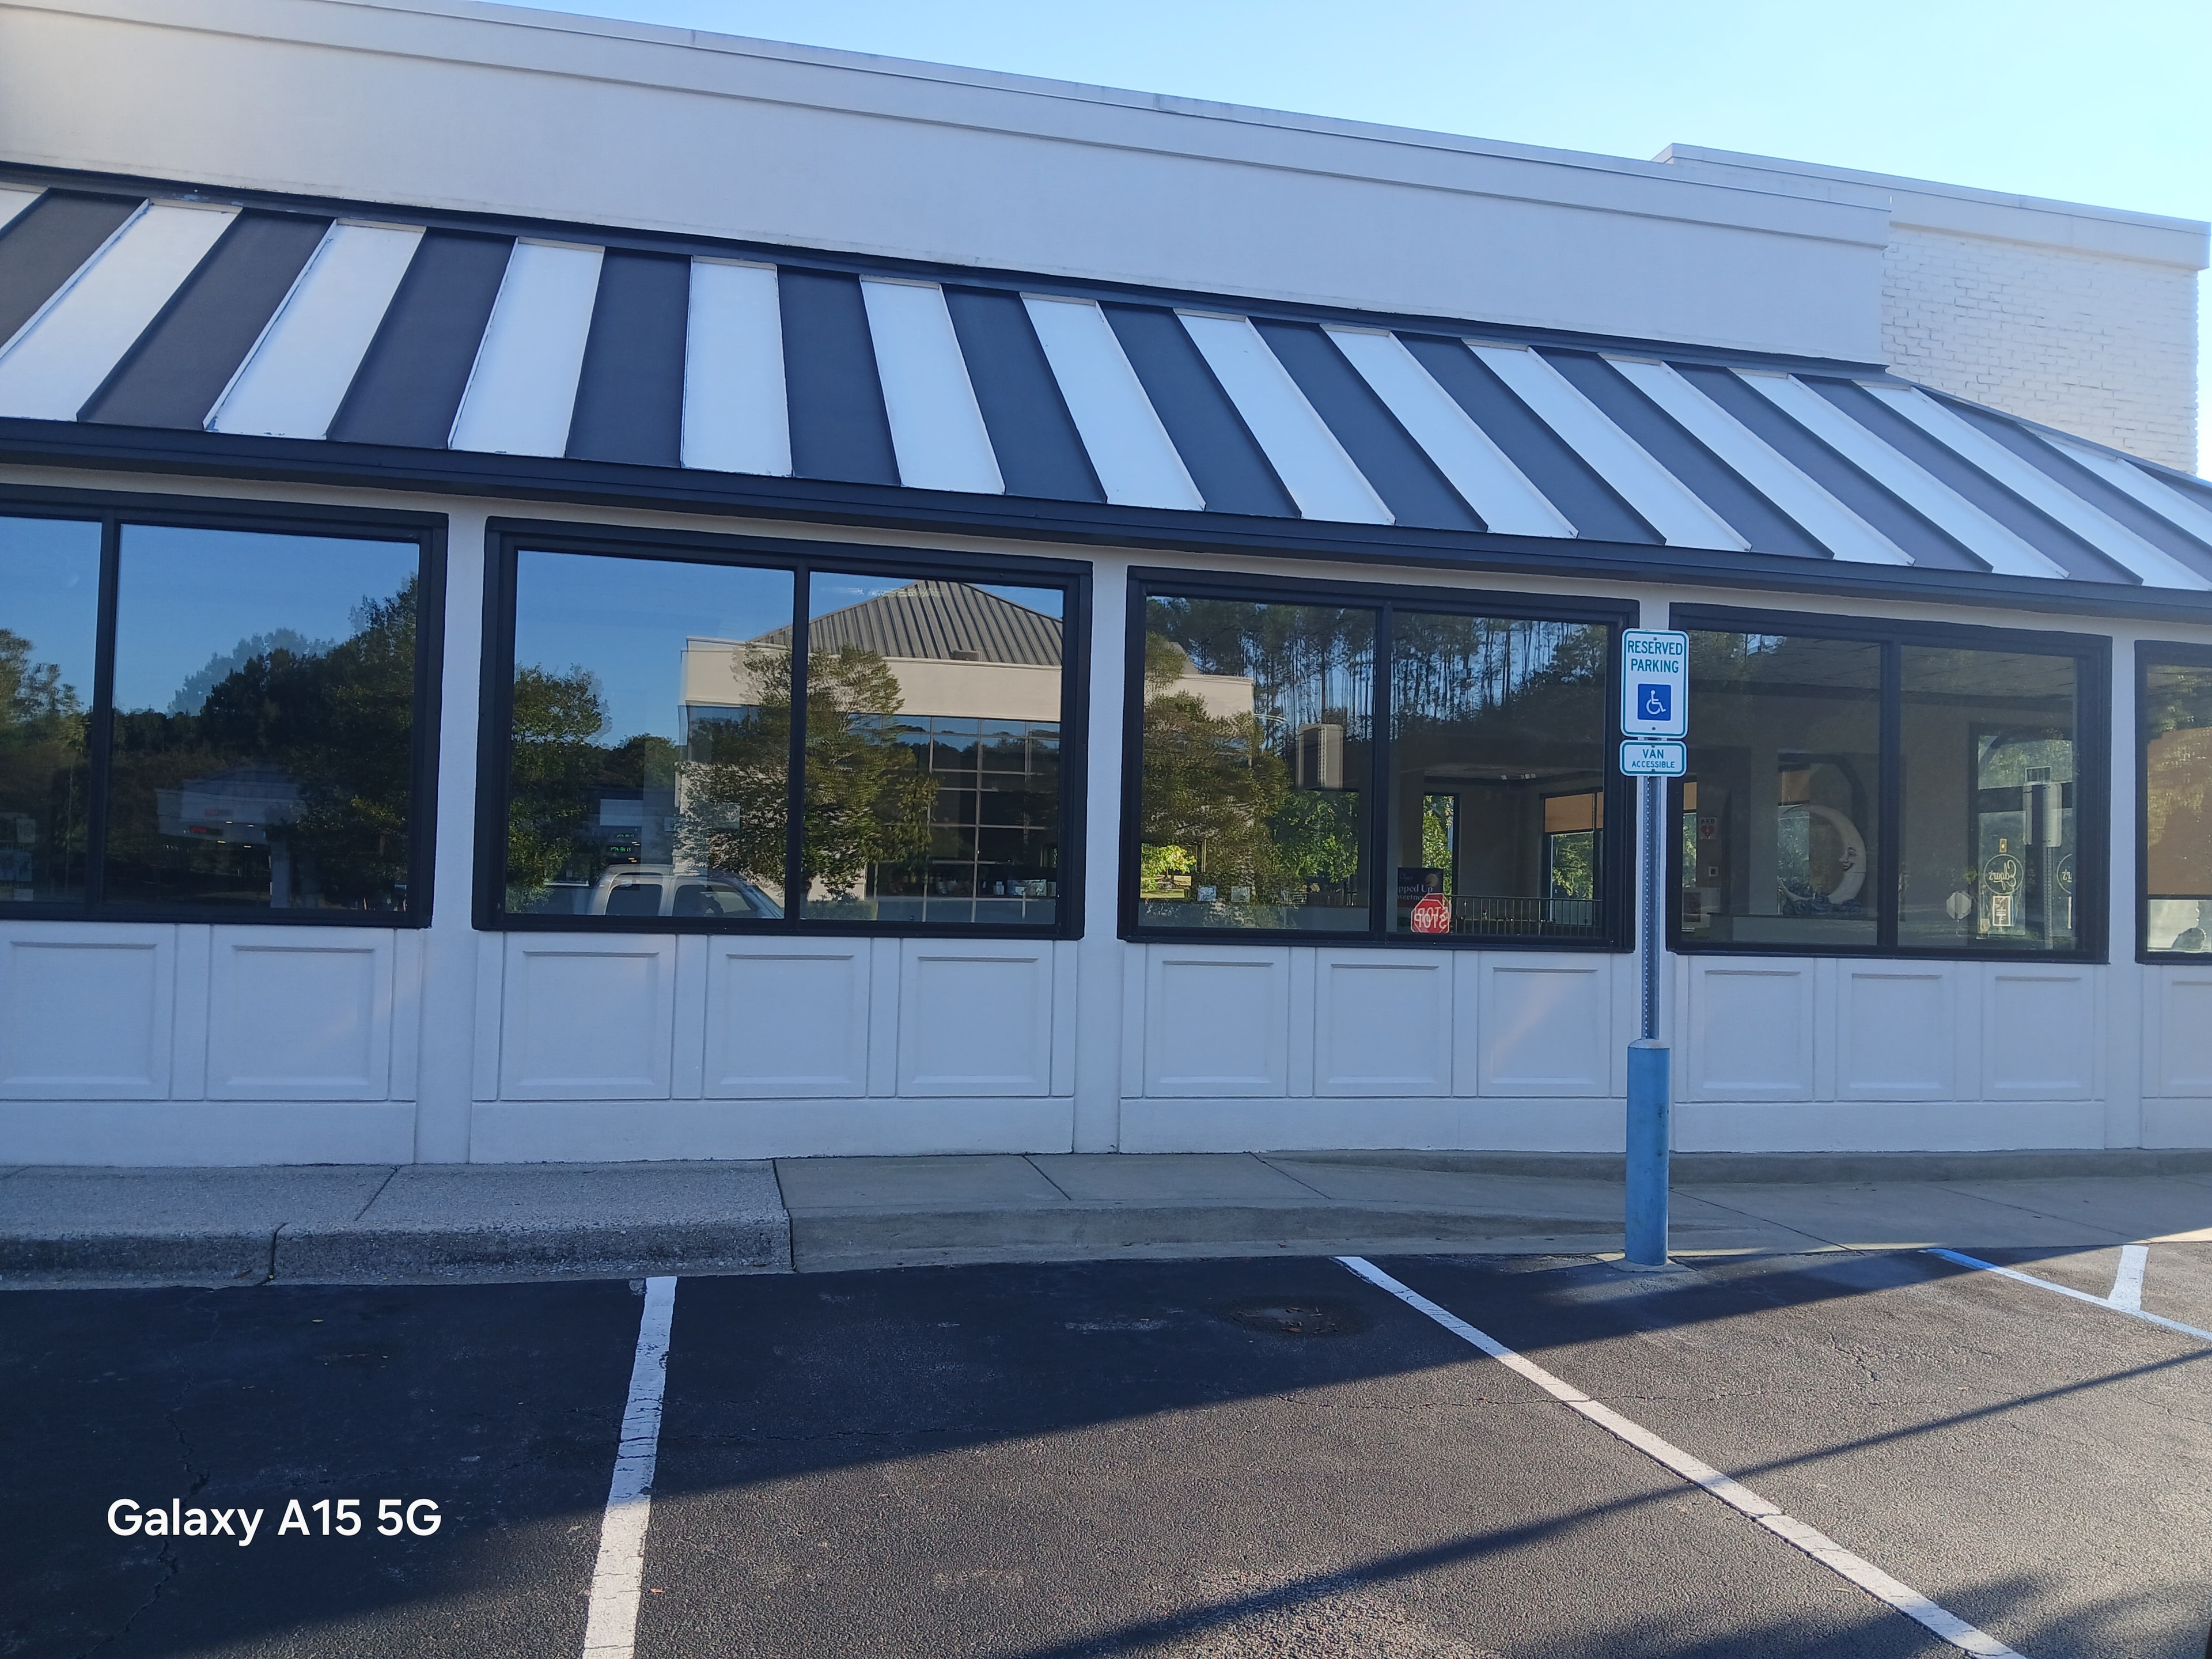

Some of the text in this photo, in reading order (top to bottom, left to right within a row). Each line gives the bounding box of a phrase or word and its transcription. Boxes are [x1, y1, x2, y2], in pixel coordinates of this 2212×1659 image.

[1627, 640, 1683, 656] RESERVED
[1631, 658, 1679, 673] PARKING
[1642, 749, 1664, 759] VAN
[1631, 760, 1675, 768] ACCESSIBLE
[1421, 884, 1433, 894] Up
